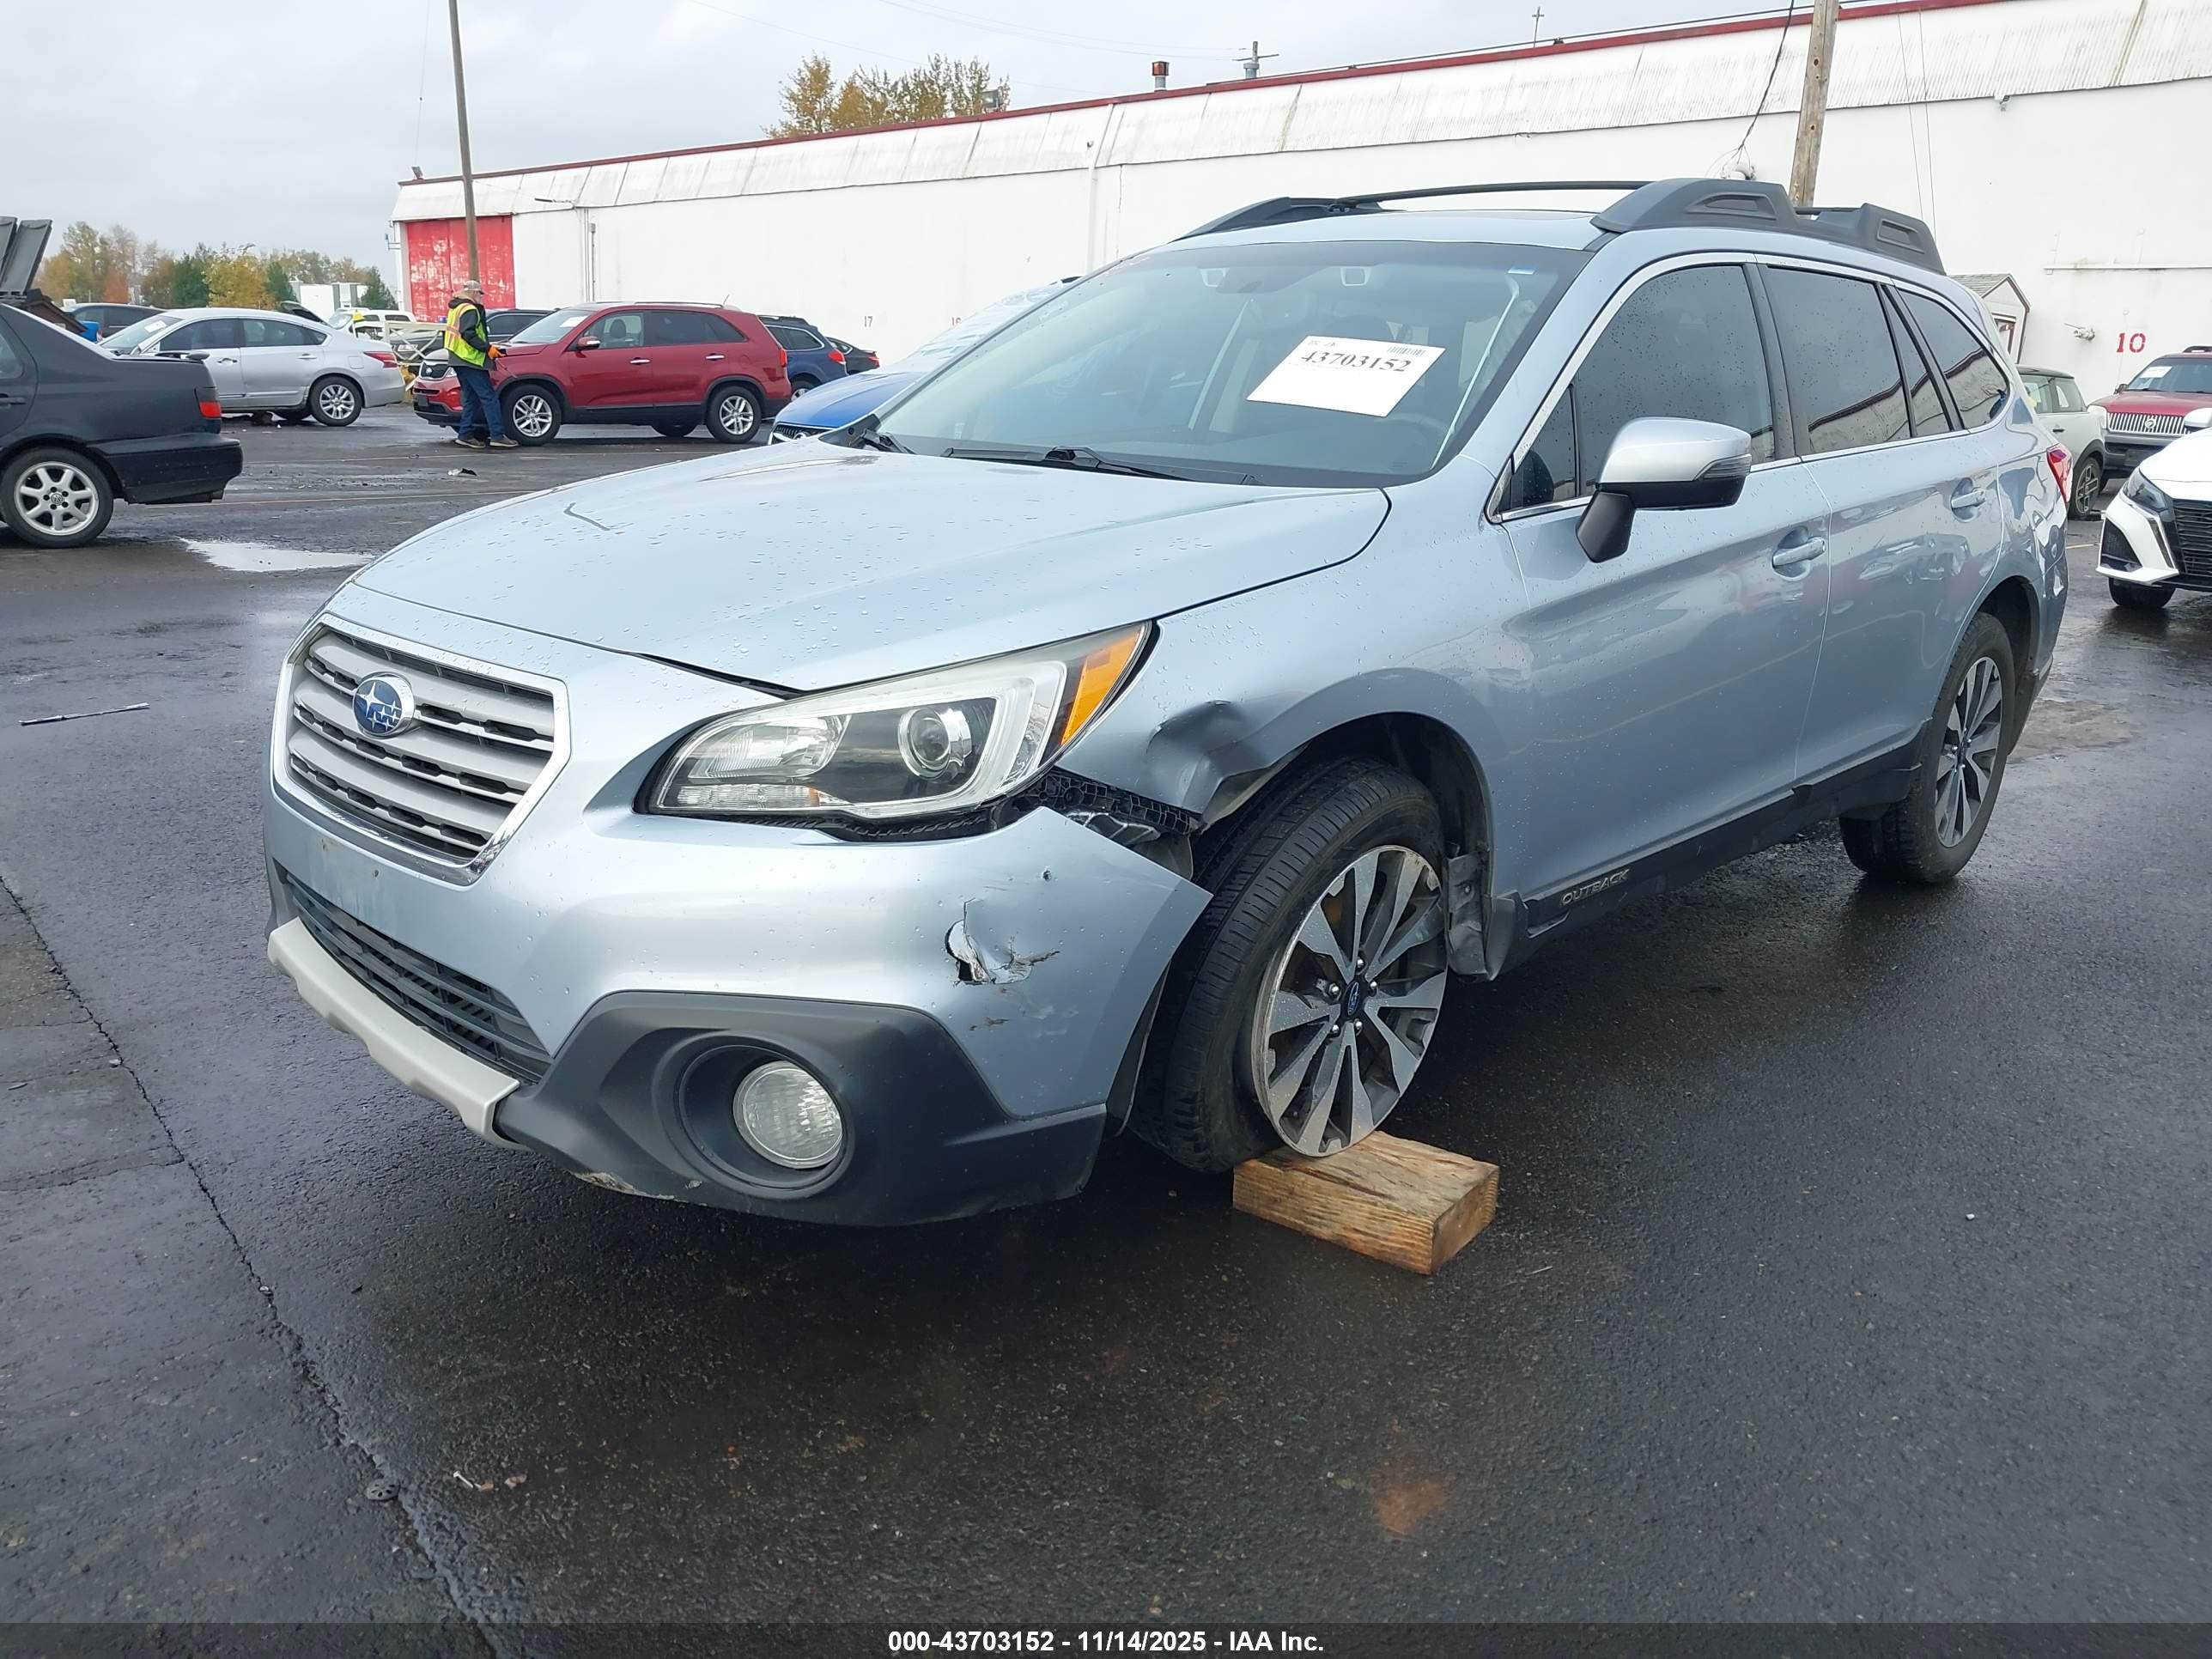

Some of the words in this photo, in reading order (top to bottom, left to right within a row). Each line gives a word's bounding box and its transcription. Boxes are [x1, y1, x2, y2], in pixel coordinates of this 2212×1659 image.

[864, 315, 873, 327] 17
[2116, 332, 2146, 354] 10
[1301, 350, 1412, 372] 43703152
[1560, 868, 1630, 905] OUTBACK
